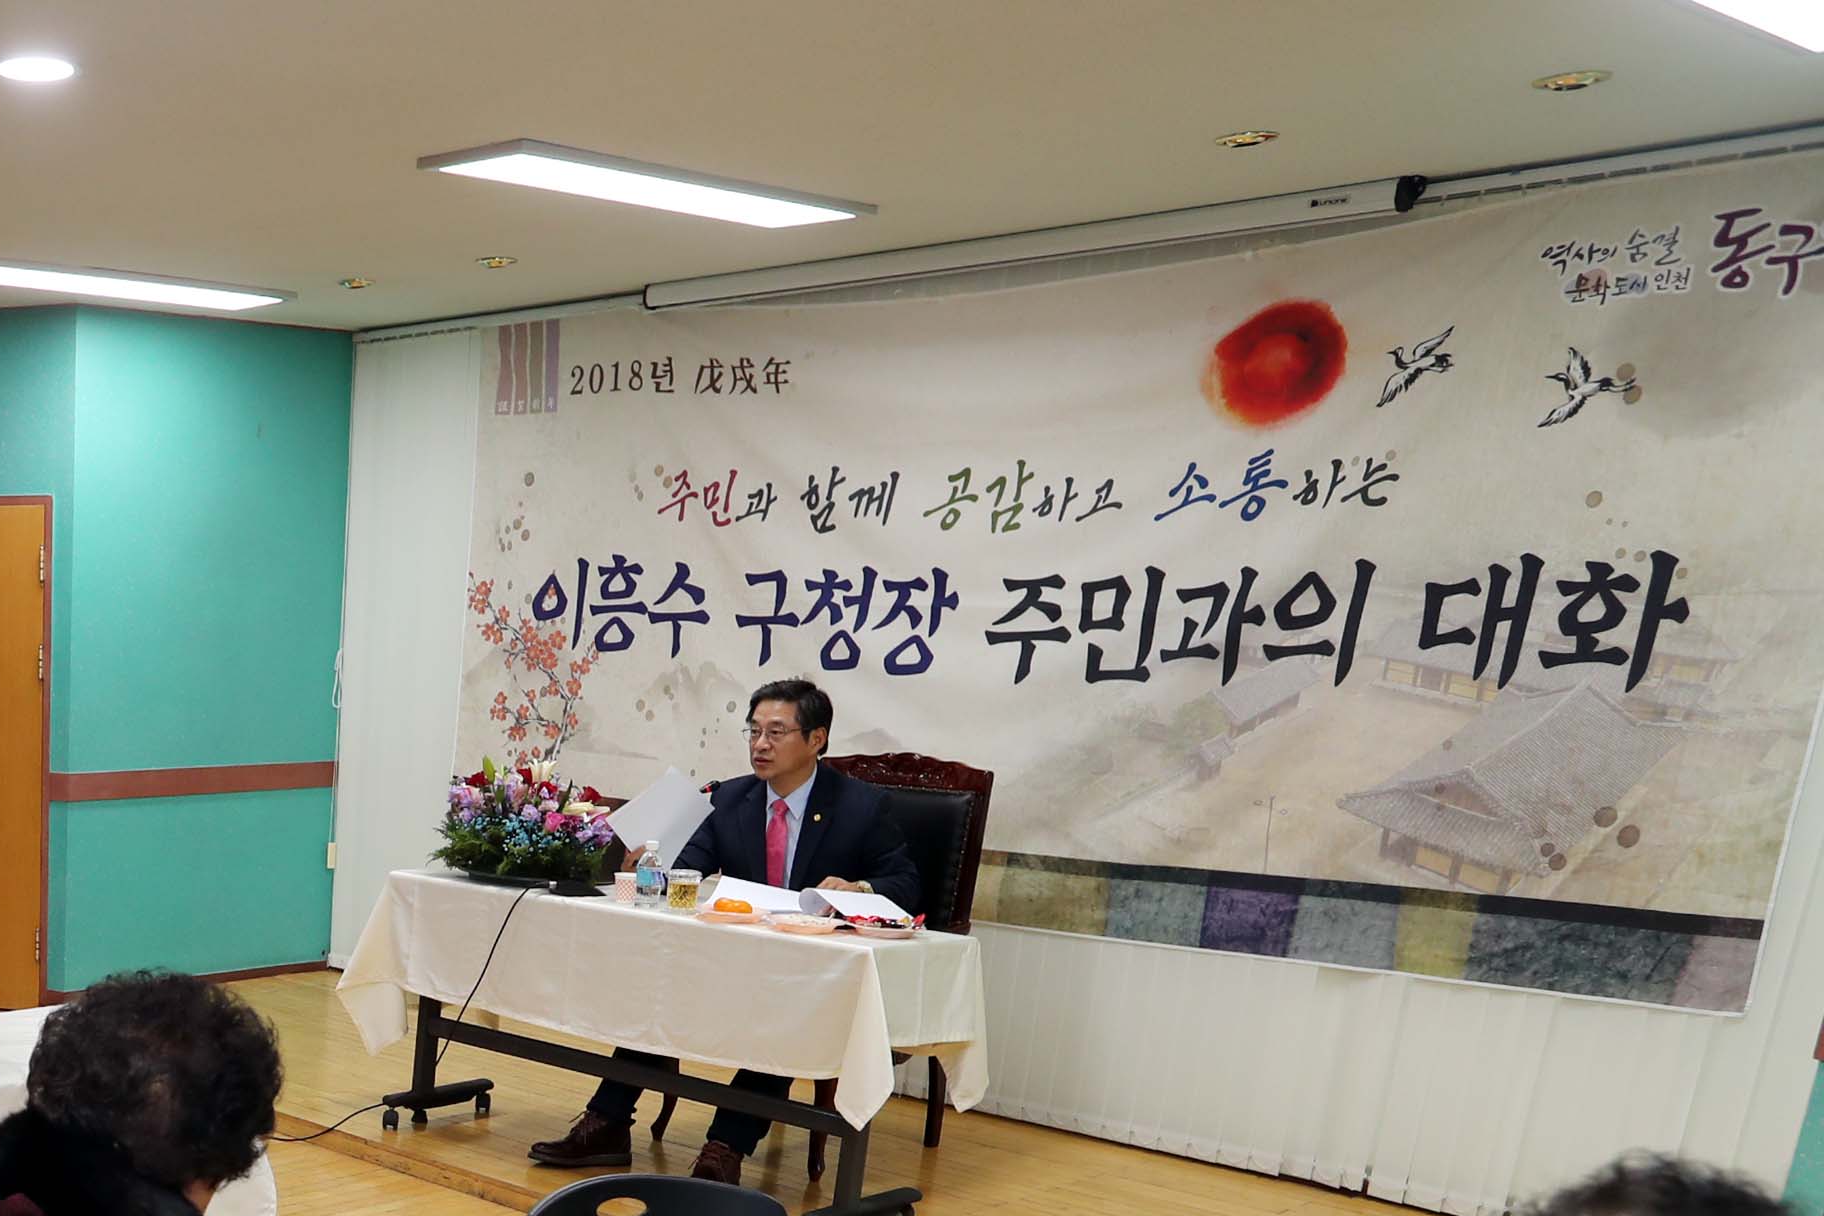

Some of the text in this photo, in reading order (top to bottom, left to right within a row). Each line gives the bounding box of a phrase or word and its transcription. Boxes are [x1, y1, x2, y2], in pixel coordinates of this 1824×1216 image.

[1541, 225, 1682, 276] 역사의 숨결
[1654, 266, 1690, 292] 인천
[1710, 207, 1824, 296] 동구
[570, 356, 793, 396] 2018년 戊戌年
[657, 448, 1400, 534] 주민과 함께 공감하고 소통하는
[532, 549, 1691, 693] 이흥수 구청장 주민과의 대화
